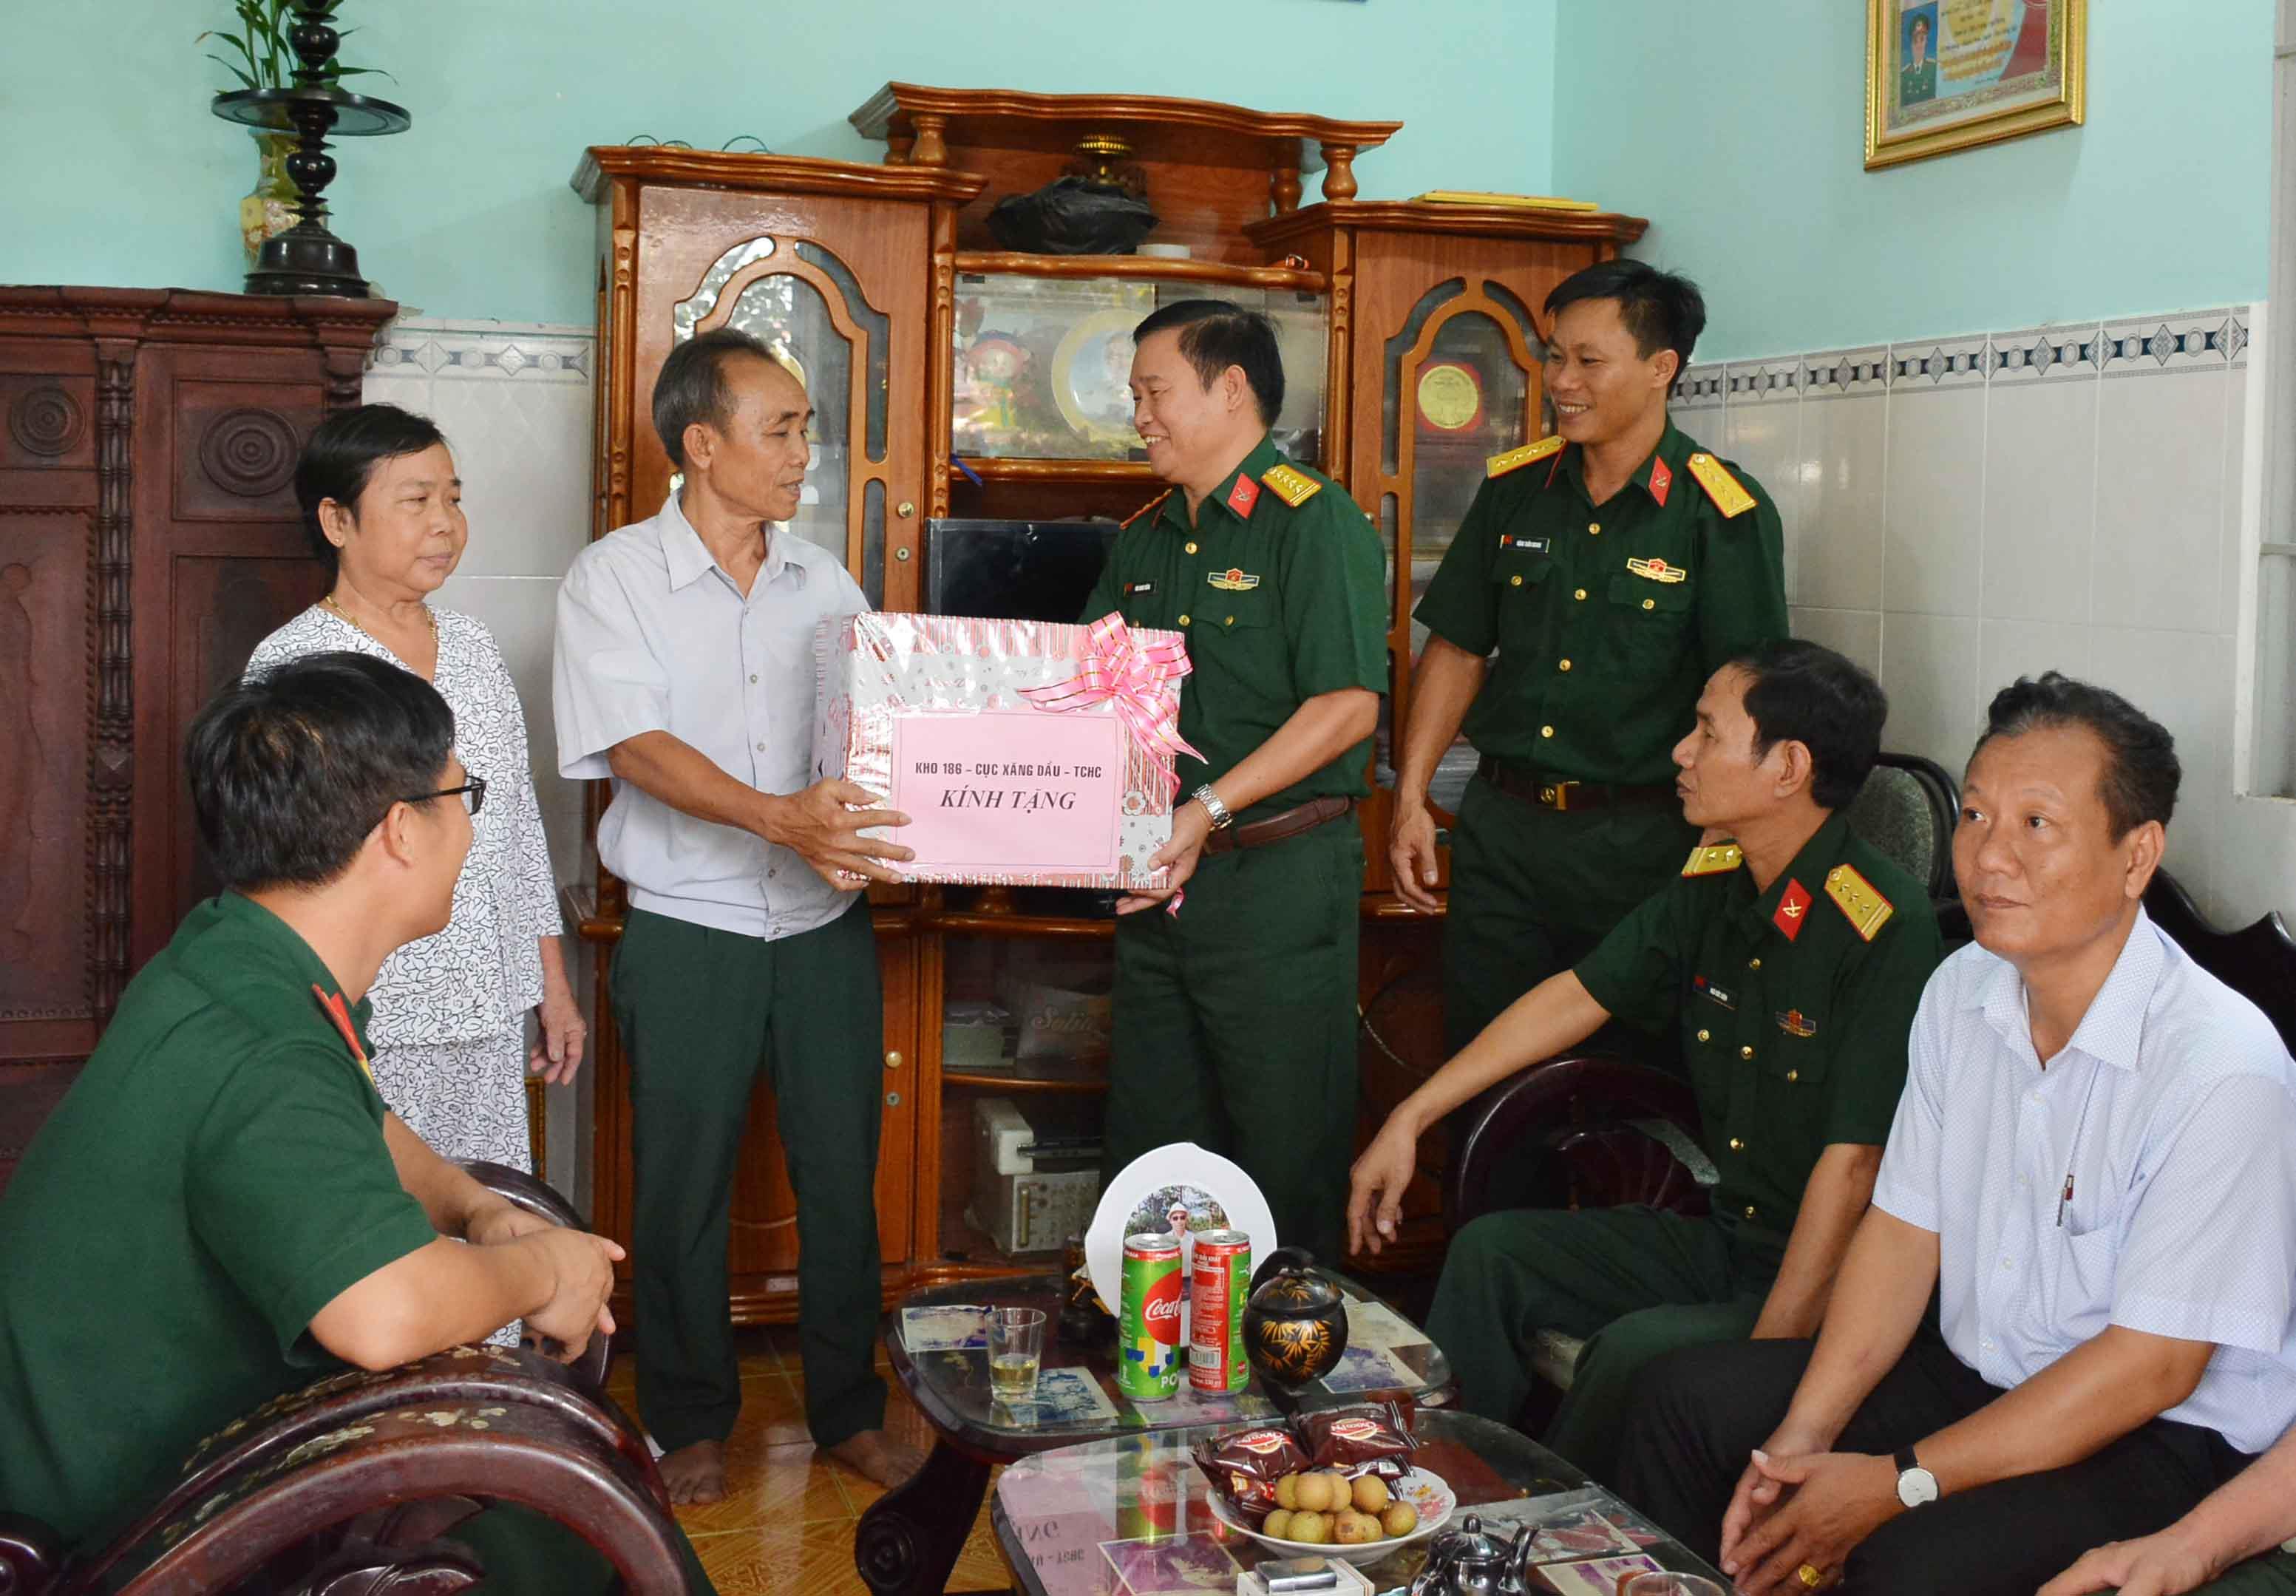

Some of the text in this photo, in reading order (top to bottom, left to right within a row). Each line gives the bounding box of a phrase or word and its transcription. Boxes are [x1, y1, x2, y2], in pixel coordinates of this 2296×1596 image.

[915, 762, 938, 774] KHO
[942, 762, 962, 775] 186
[975, 763, 998, 778] CỤC
[1074, 766, 1102, 778] TCHC
[940, 784, 1076, 813] KÍNH TẶNG
